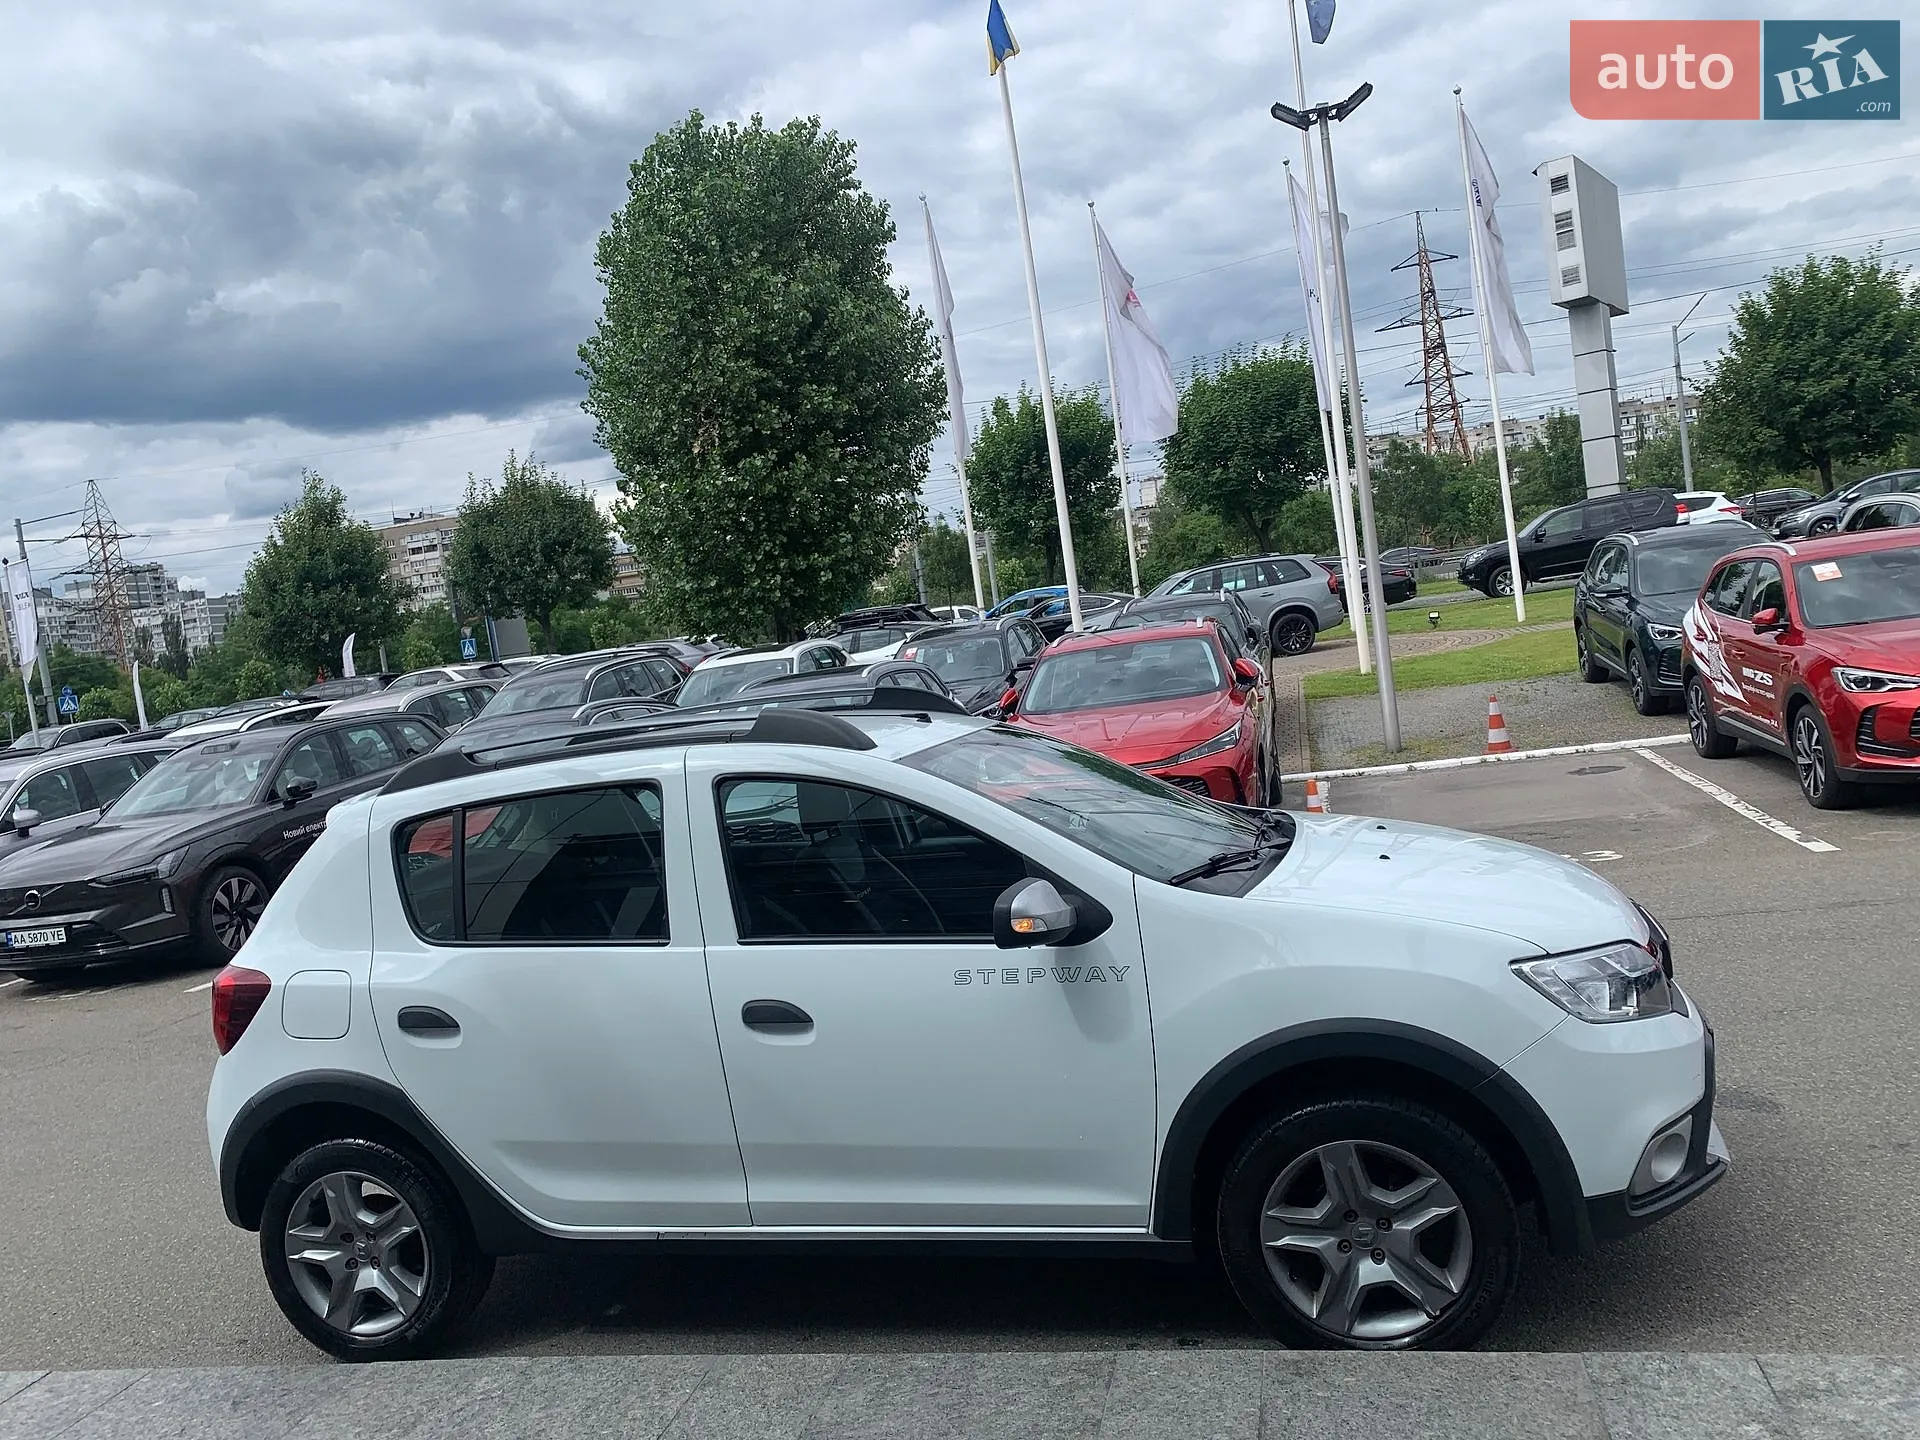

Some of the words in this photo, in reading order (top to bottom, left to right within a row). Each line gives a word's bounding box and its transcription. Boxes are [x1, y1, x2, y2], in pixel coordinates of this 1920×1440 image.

[13, 933, 27, 945] AA
[28, 931, 49, 944] 5870
[50, 929, 65, 941] YE
[953, 965, 1131, 986] STEPWAY
